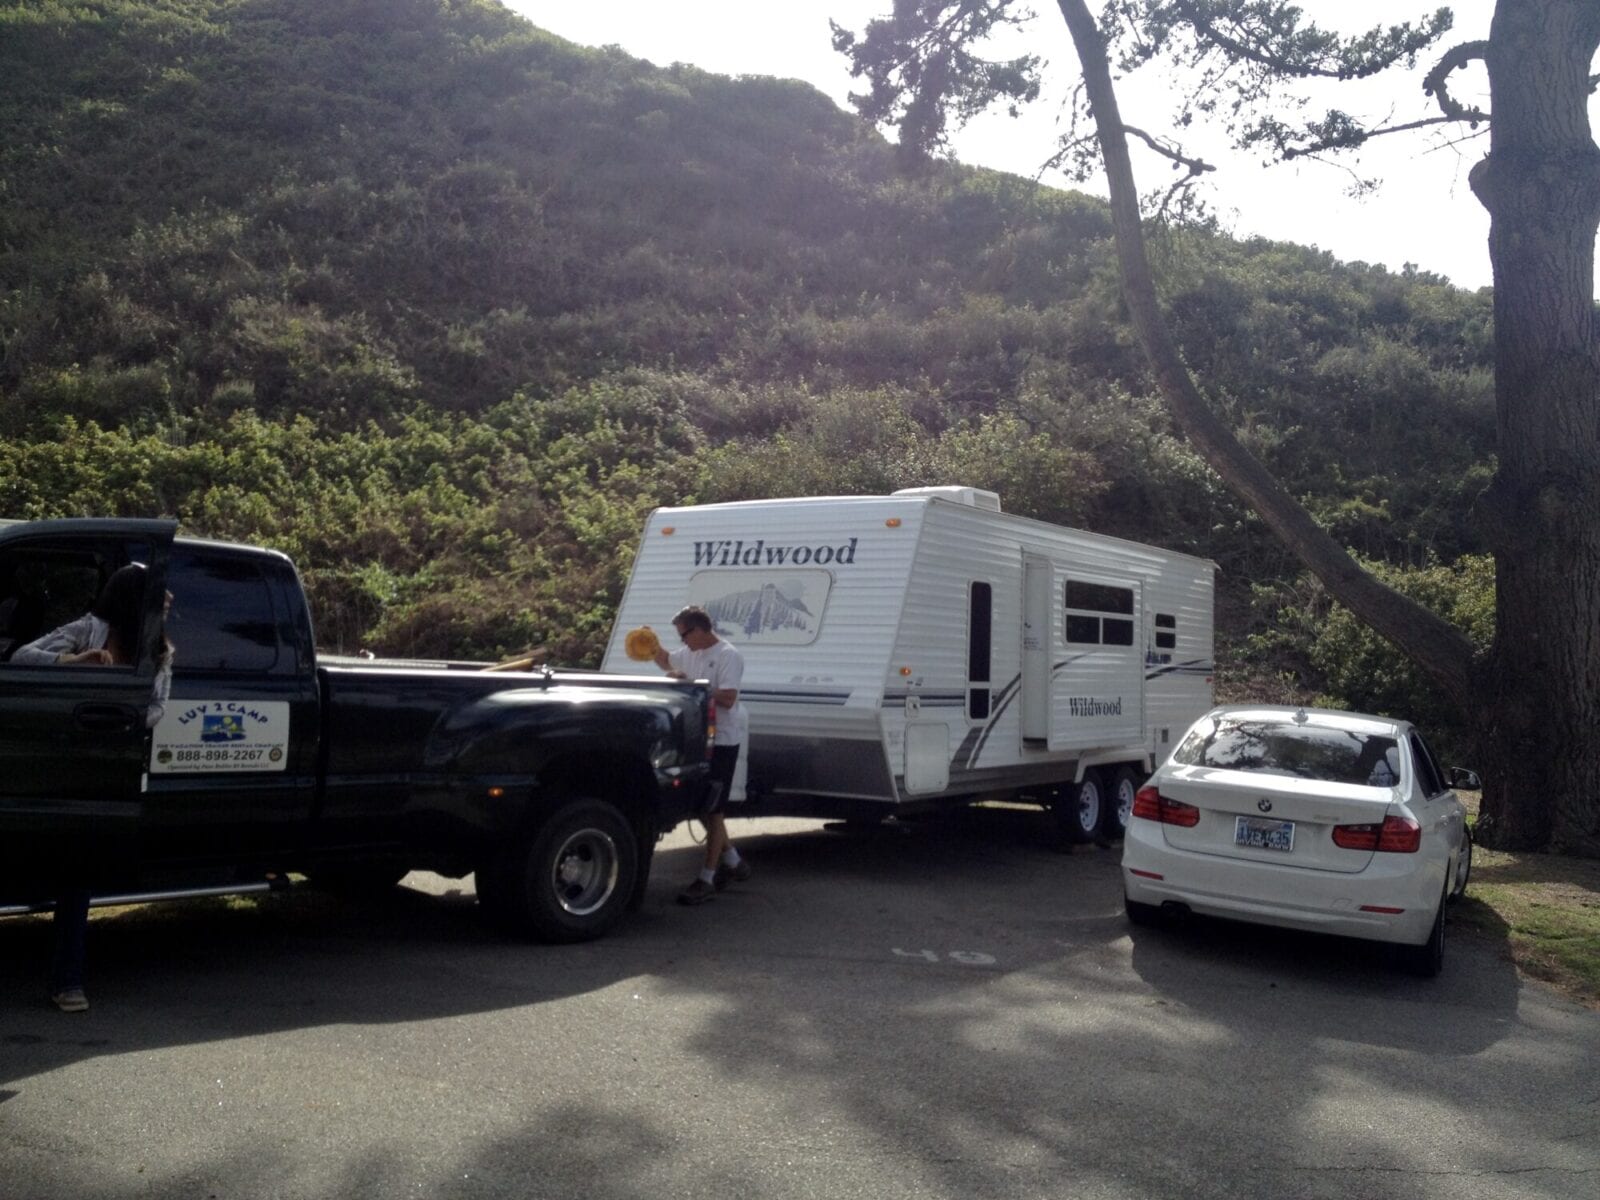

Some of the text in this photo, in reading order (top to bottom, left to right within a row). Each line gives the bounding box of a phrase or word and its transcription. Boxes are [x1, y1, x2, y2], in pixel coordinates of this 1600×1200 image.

[693, 537, 858, 566] Wildwood
[178, 702, 269, 725] LUV 2 CAMP
[1069, 697, 1122, 717] Wildwood
[176, 750, 264, 761] 888-898-2267
